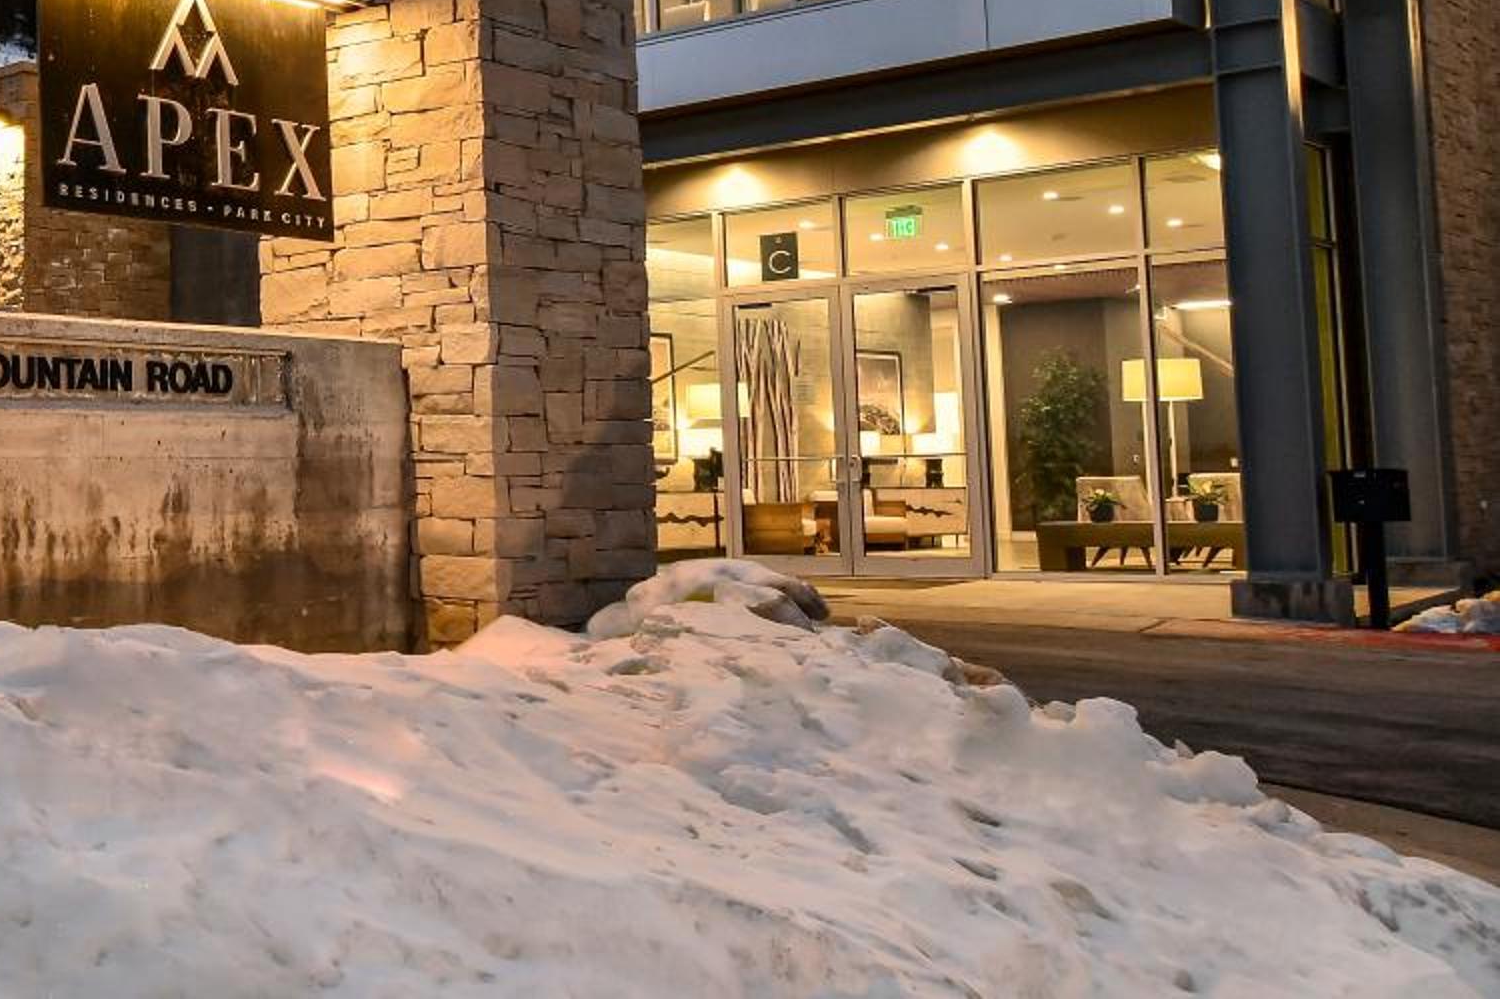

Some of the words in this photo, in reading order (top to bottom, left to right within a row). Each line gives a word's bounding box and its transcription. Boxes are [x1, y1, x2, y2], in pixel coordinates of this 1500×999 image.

[56, 82, 327, 202] APEX
[58, 183, 197, 212] RESIDENCES
[223, 204, 273, 222] PARK
[281, 213, 325, 229] CITY
[769, 250, 791, 274] C
[146, 360, 234, 394] ROAD
